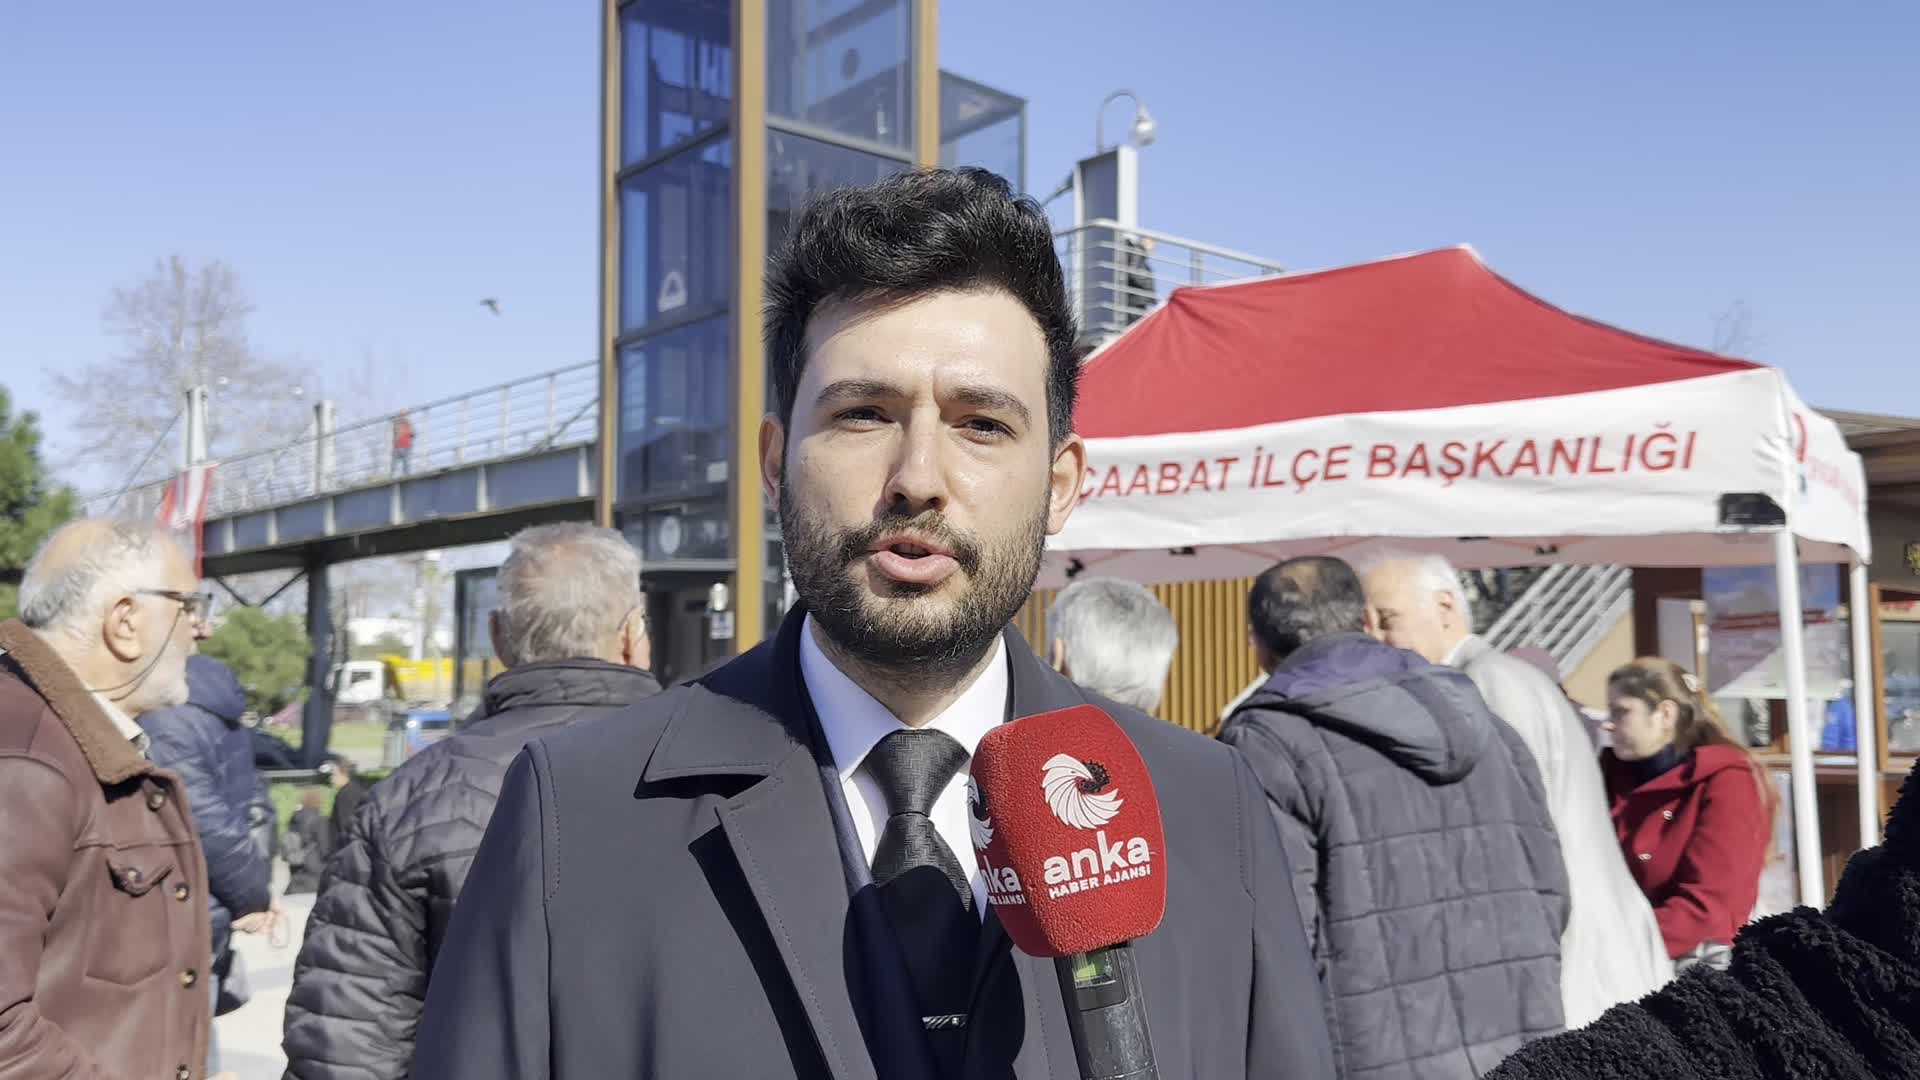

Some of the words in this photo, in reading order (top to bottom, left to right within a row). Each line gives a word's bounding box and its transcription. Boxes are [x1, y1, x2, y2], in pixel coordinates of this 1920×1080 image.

[1248, 445, 1352, 493] İLÇE
[1366, 422, 1697, 487] BAŞKANLIĞI
[1043, 830, 1151, 885] anka
[1048, 877, 1100, 899] HABER
[1103, 864, 1151, 886] AJANSI
